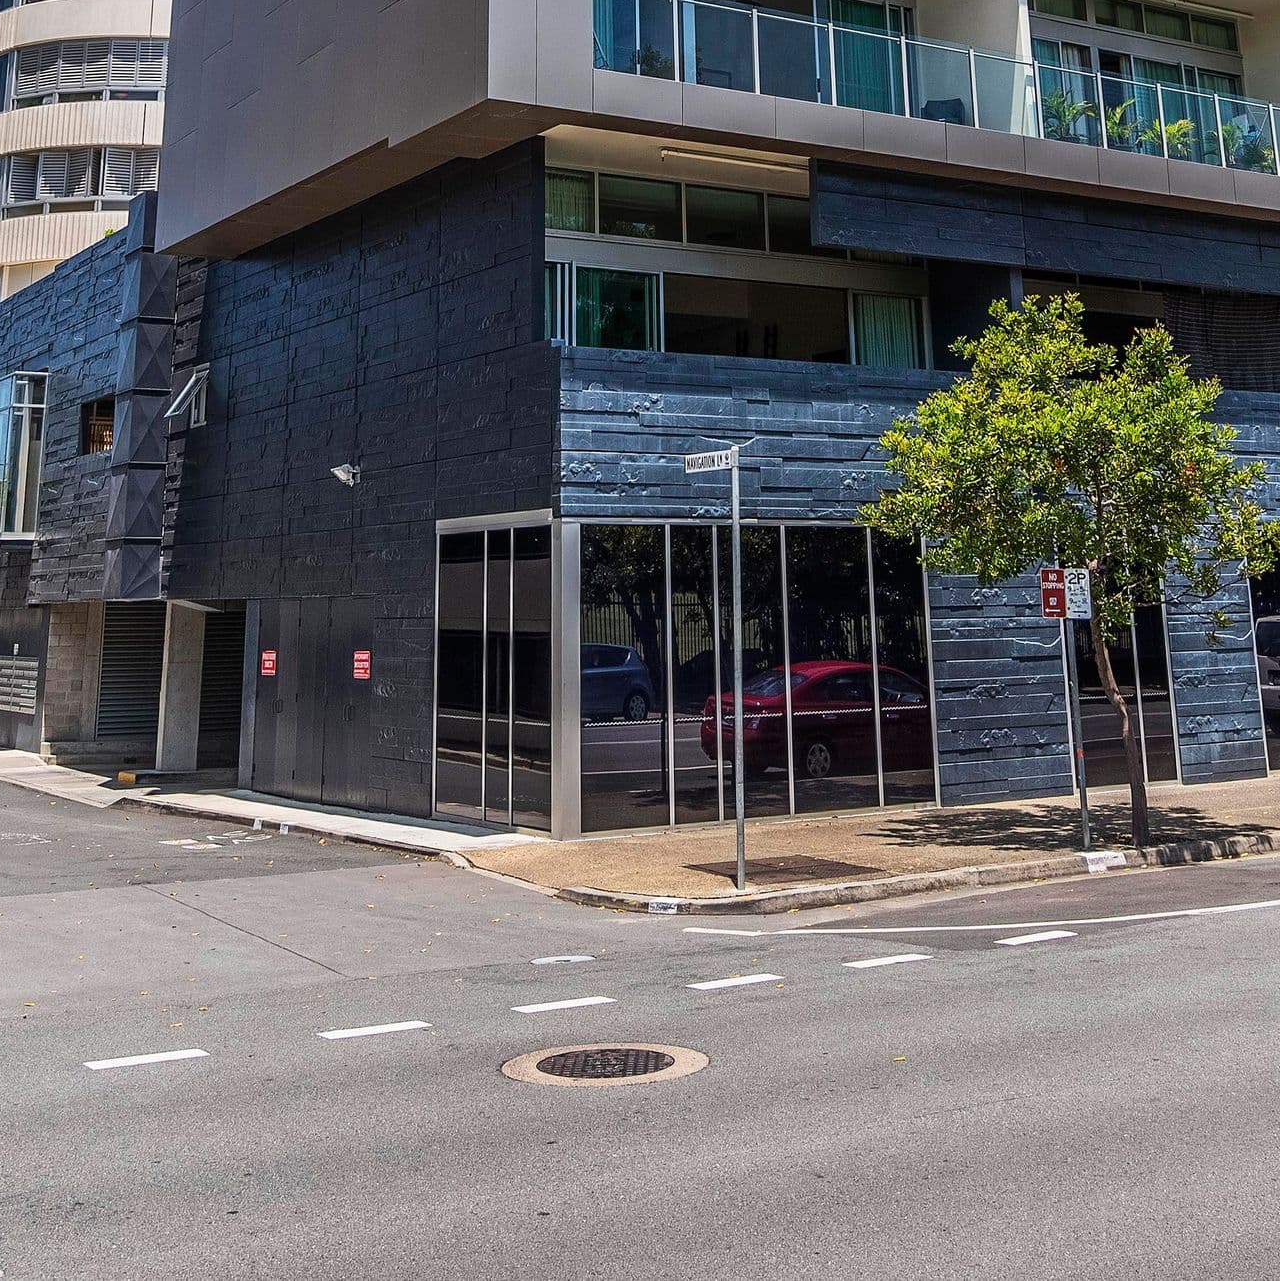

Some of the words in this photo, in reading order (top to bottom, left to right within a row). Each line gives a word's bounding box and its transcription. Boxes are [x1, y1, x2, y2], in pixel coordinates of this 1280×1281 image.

[687, 455, 715, 471] NAVIGATION
[1048, 573, 1058, 581] NO
[1067, 572, 1086, 585] 2P
[1042, 582, 1065, 590] STOPPING
